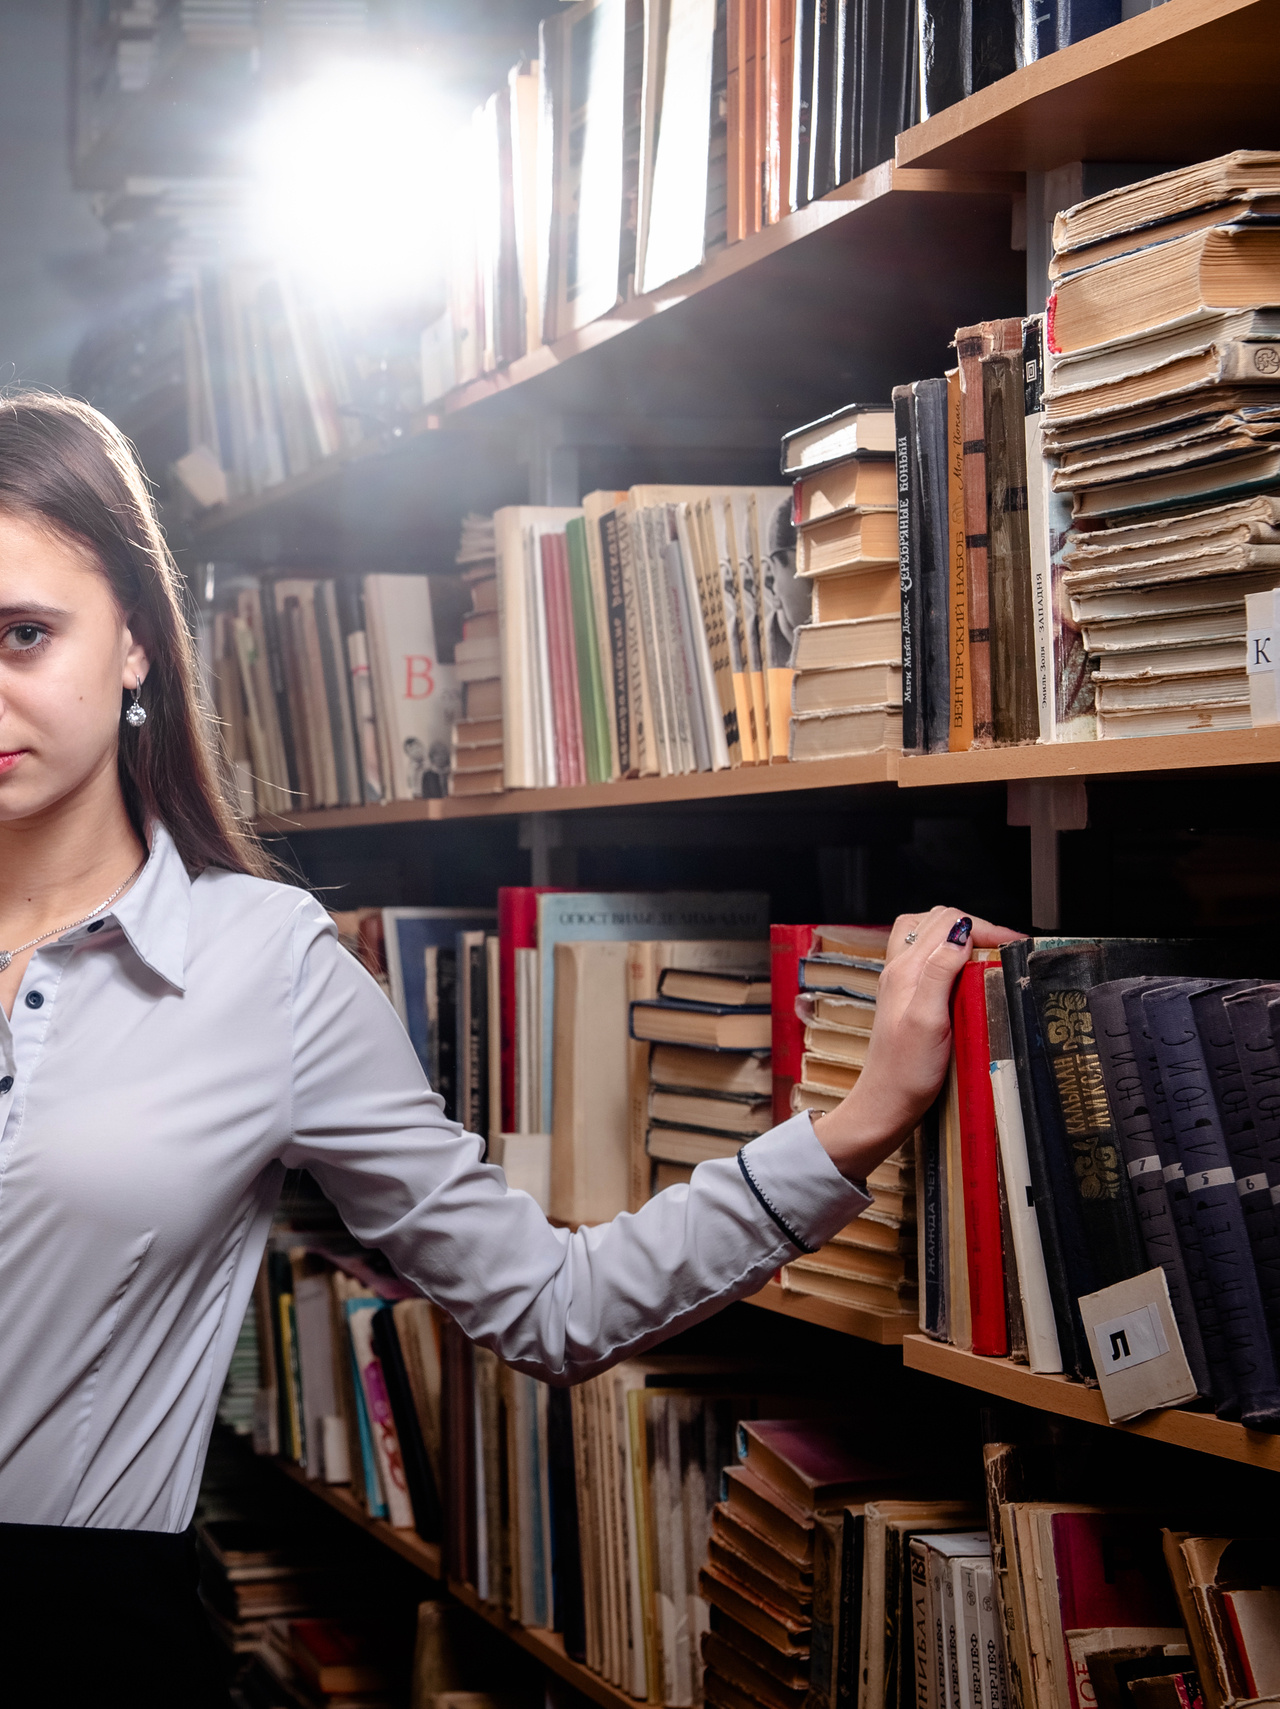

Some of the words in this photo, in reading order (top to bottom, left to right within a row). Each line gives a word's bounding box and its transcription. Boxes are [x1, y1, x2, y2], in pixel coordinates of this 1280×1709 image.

[954, 530, 966, 595] НАБОБ
[1035, 572, 1045, 633] ЗАПАДНЯ
[952, 601, 967, 729] ВЕНГЕРСКИЙ
[1252, 638, 1272, 666] К
[1052, 1055, 1076, 1136] КАЛЬМАН
[1076, 1051, 1112, 1129] МИКСАТ
[1160, 1029, 1219, 1157] ЛЬЮИС
[1138, 1159, 1147, 1172] 7
[1200, 1172, 1210, 1186] 5
[1245, 1178, 1256, 1191] 6
[926, 1201, 936, 1276] ЖАЖДА
[1195, 1200, 1258, 1378] СИНКЛЕР
[1109, 1329, 1132, 1362] Л
